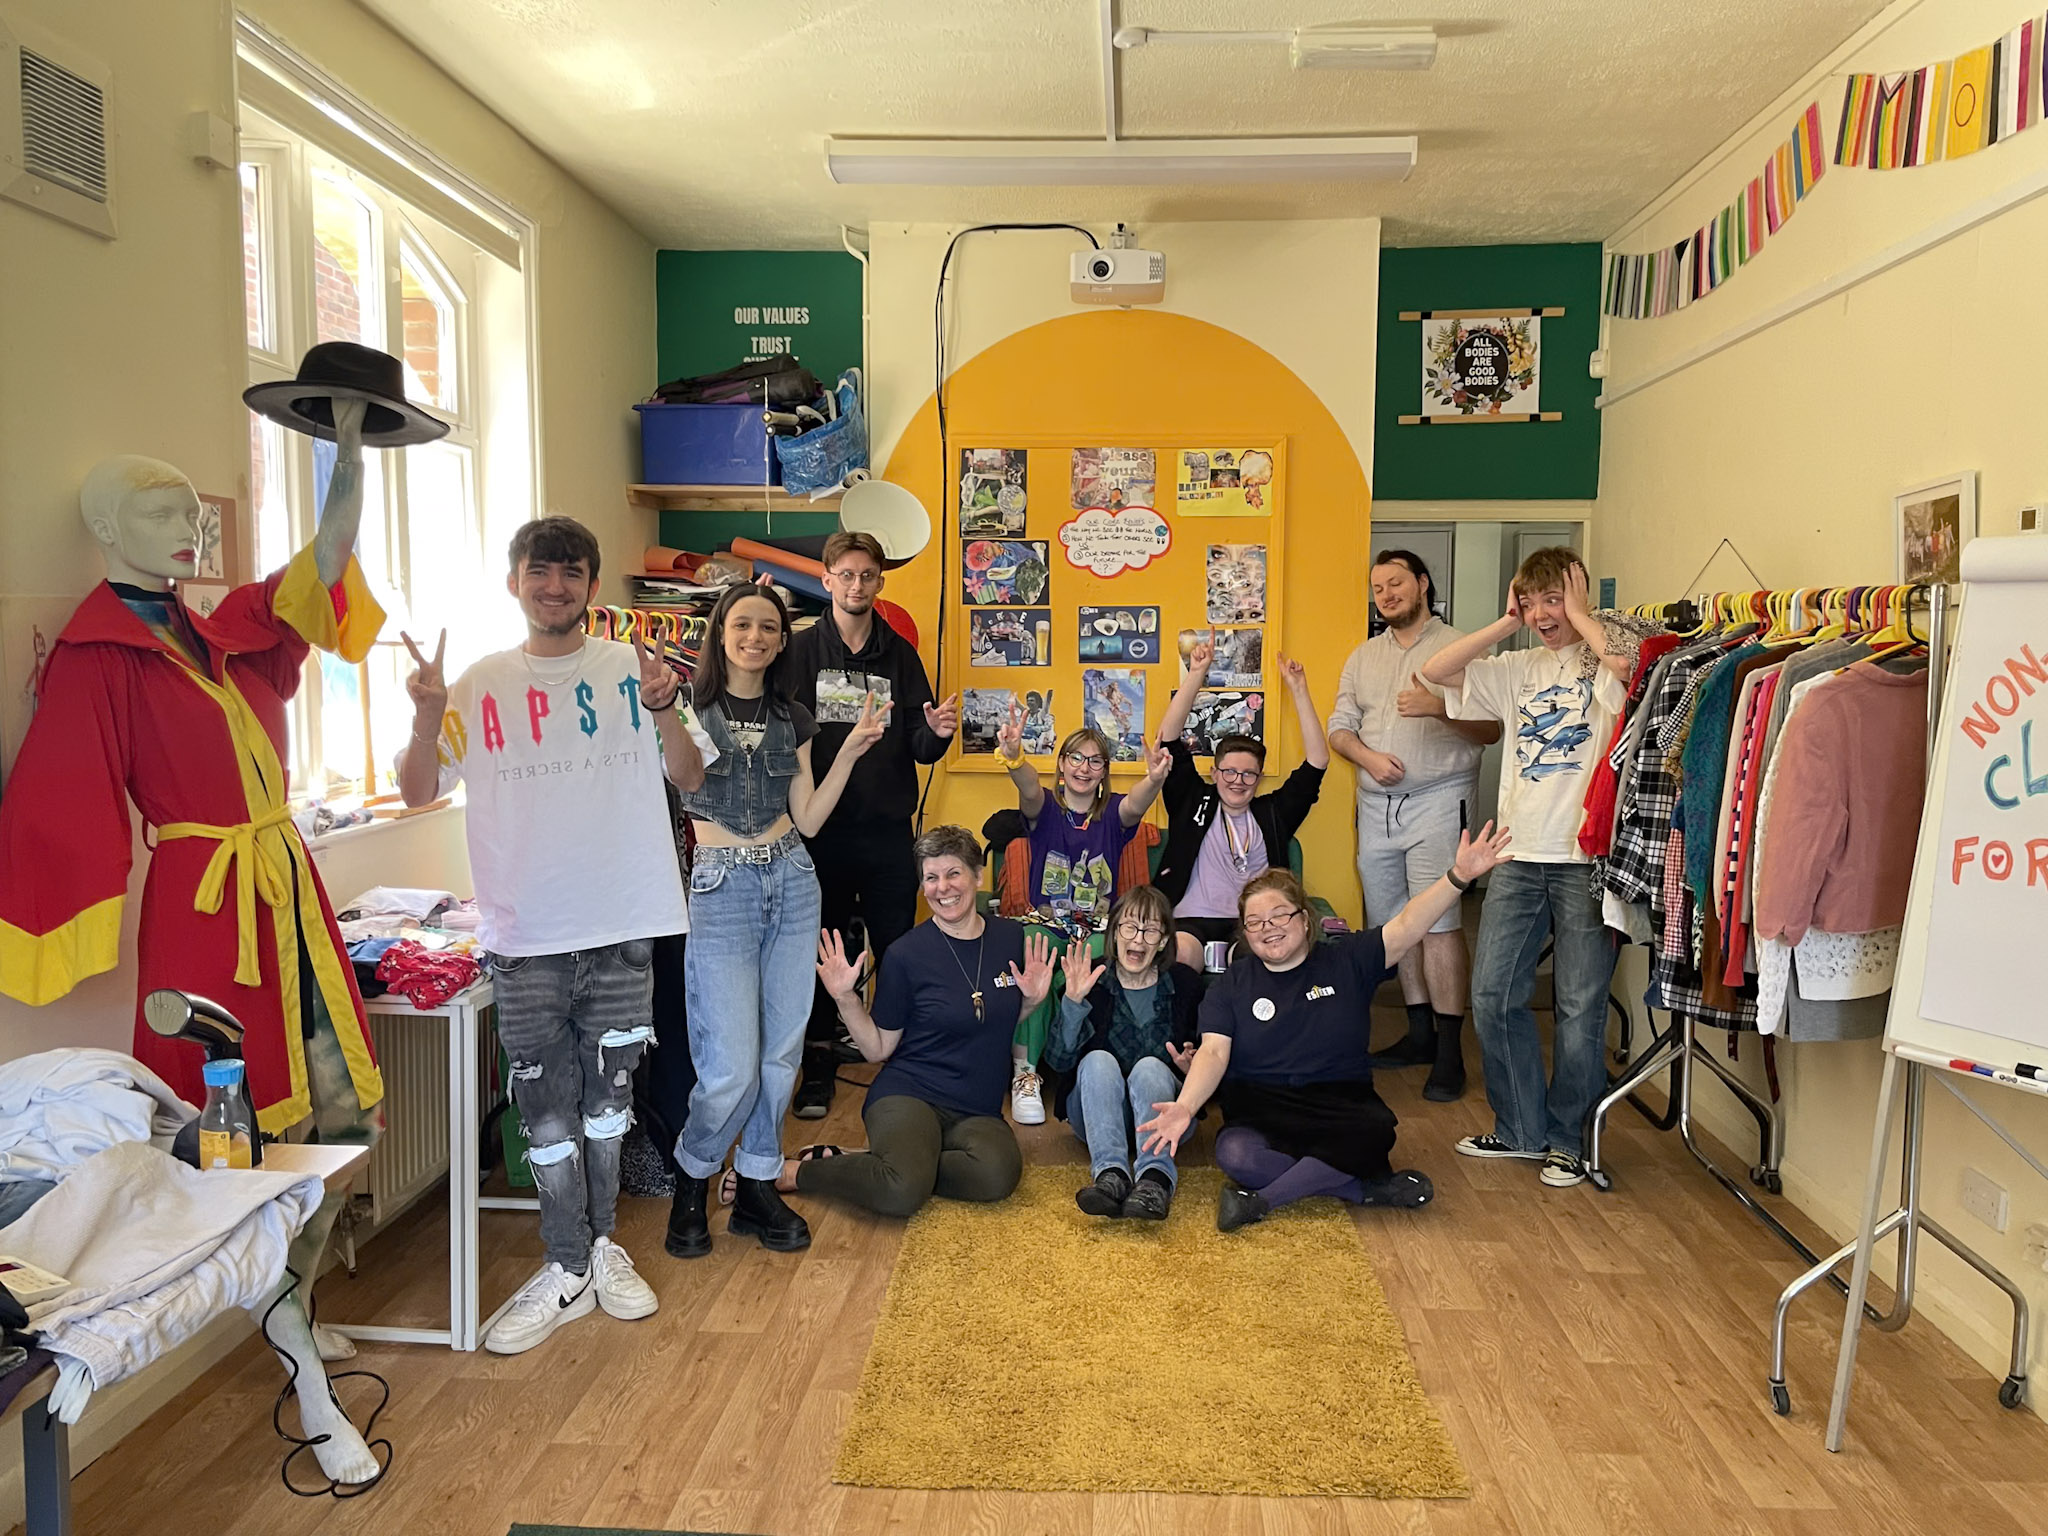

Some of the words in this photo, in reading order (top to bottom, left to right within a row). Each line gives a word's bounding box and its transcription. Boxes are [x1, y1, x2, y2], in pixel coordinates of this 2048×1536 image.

[734, 307, 760, 324] OUR
[762, 307, 810, 324] VALUES
[751, 336, 792, 354] TRUST
[1473, 337, 1492, 347] ALL
[1465, 347, 1500, 357] BODIES
[1472, 357, 1492, 366] ARE
[1468, 367, 1495, 376] GOOD
[1465, 376, 1499, 386] BODIES
